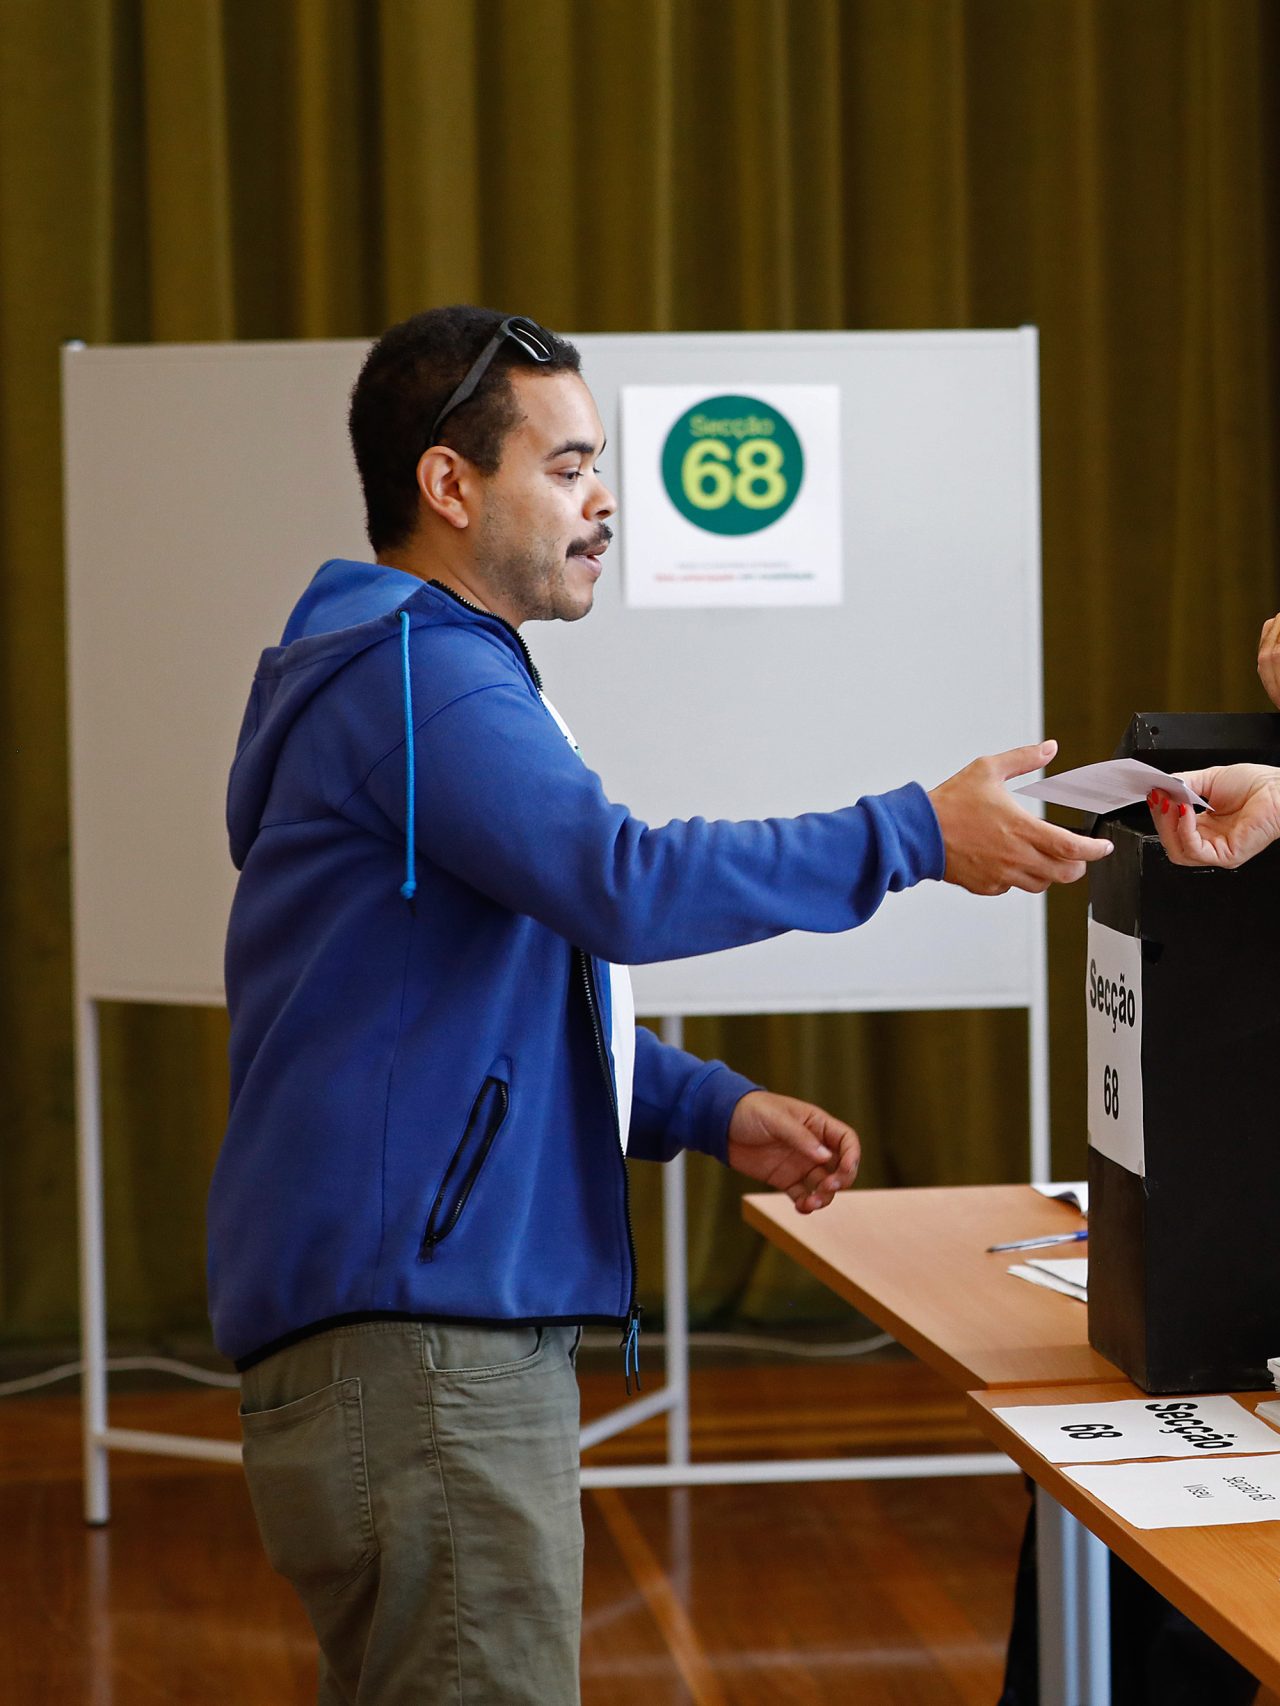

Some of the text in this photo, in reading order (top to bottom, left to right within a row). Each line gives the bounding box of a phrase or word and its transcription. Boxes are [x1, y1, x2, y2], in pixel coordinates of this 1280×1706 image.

[689, 414, 775, 438] Secção
[680, 438, 787, 511] 68
[1089, 958, 1136, 1033] Secção
[1103, 1065, 1119, 1120] 68
[1060, 1423, 1123, 1441] 68
[1145, 1402, 1237, 1450] Secção
[1222, 1476, 1276, 1502] Secção 68
